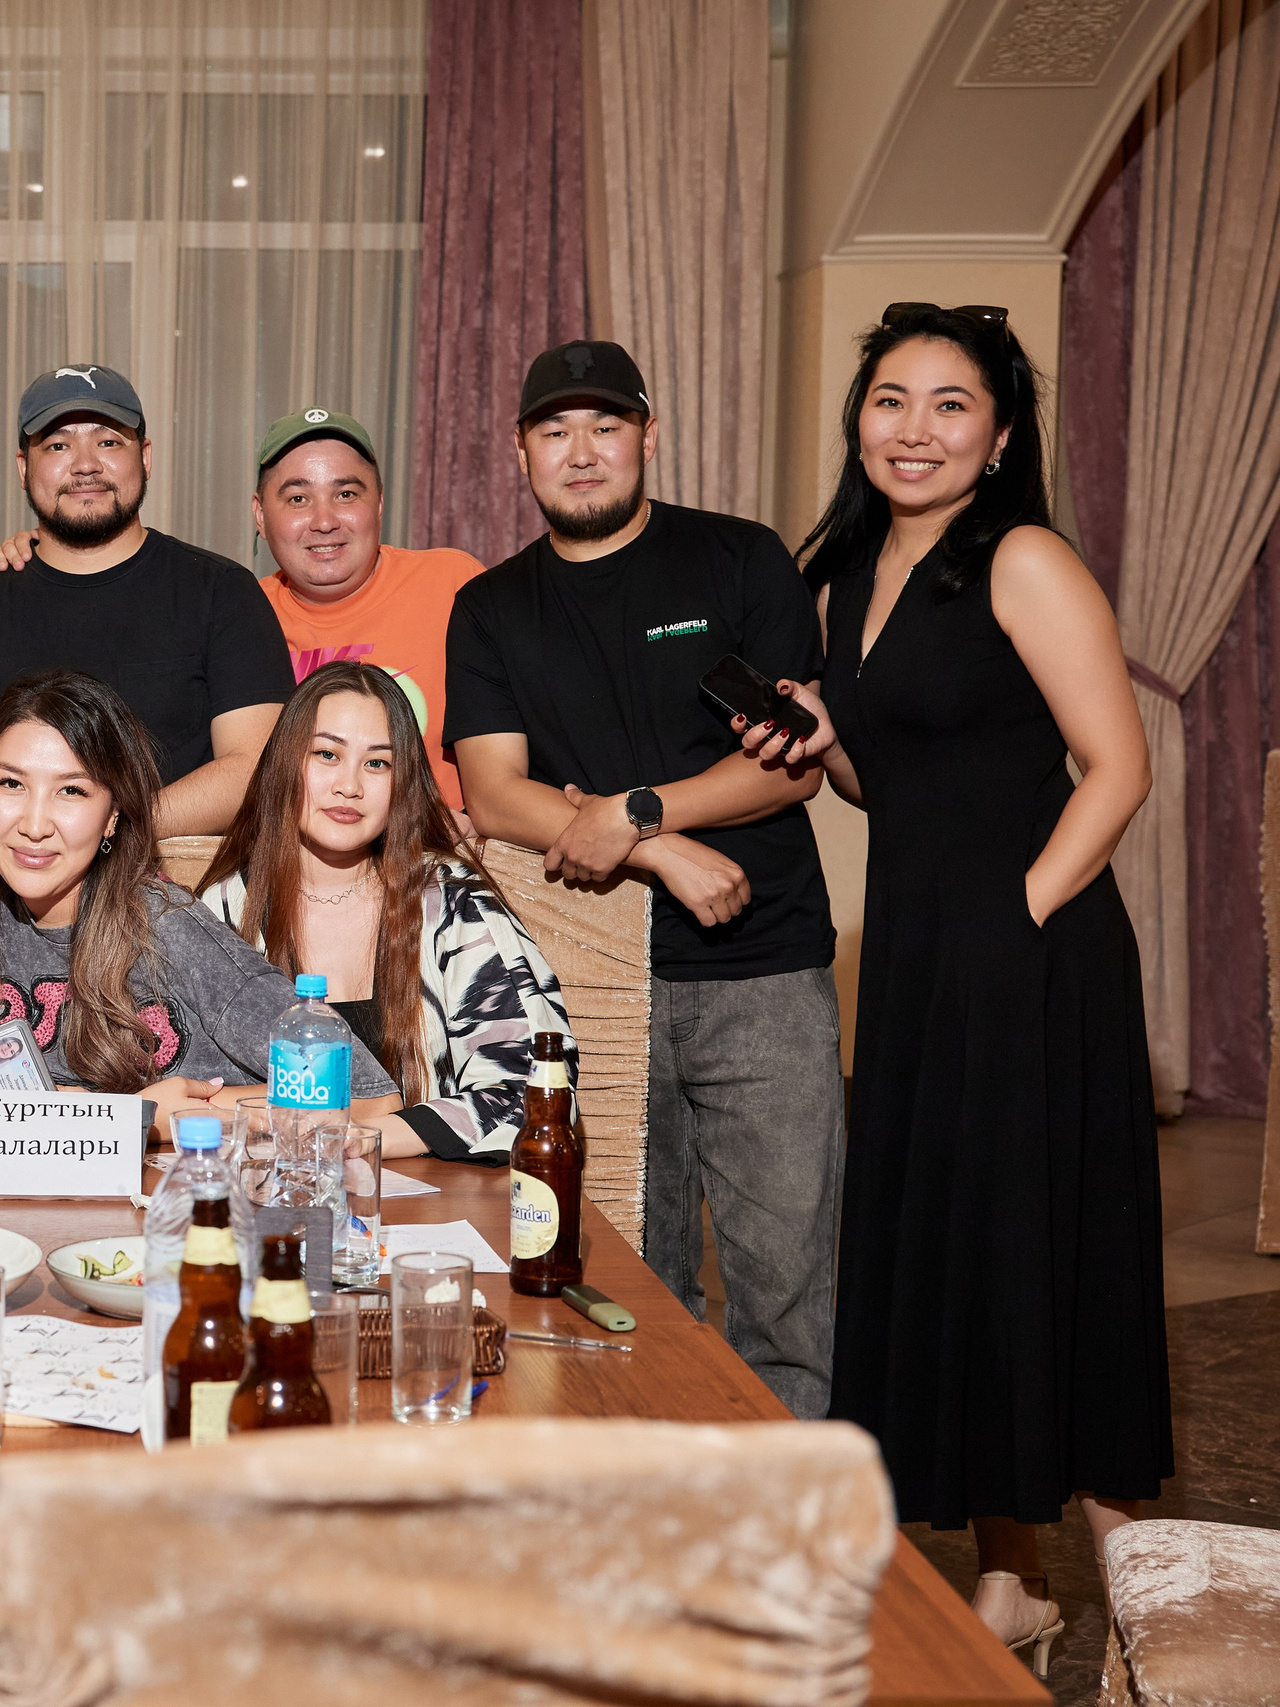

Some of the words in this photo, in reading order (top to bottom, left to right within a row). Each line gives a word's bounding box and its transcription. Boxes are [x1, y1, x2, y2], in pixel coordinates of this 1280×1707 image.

[646, 626, 664, 637] KARL
[664, 619, 708, 632] LAGERFELD
[276, 1083, 329, 1103] aqua
